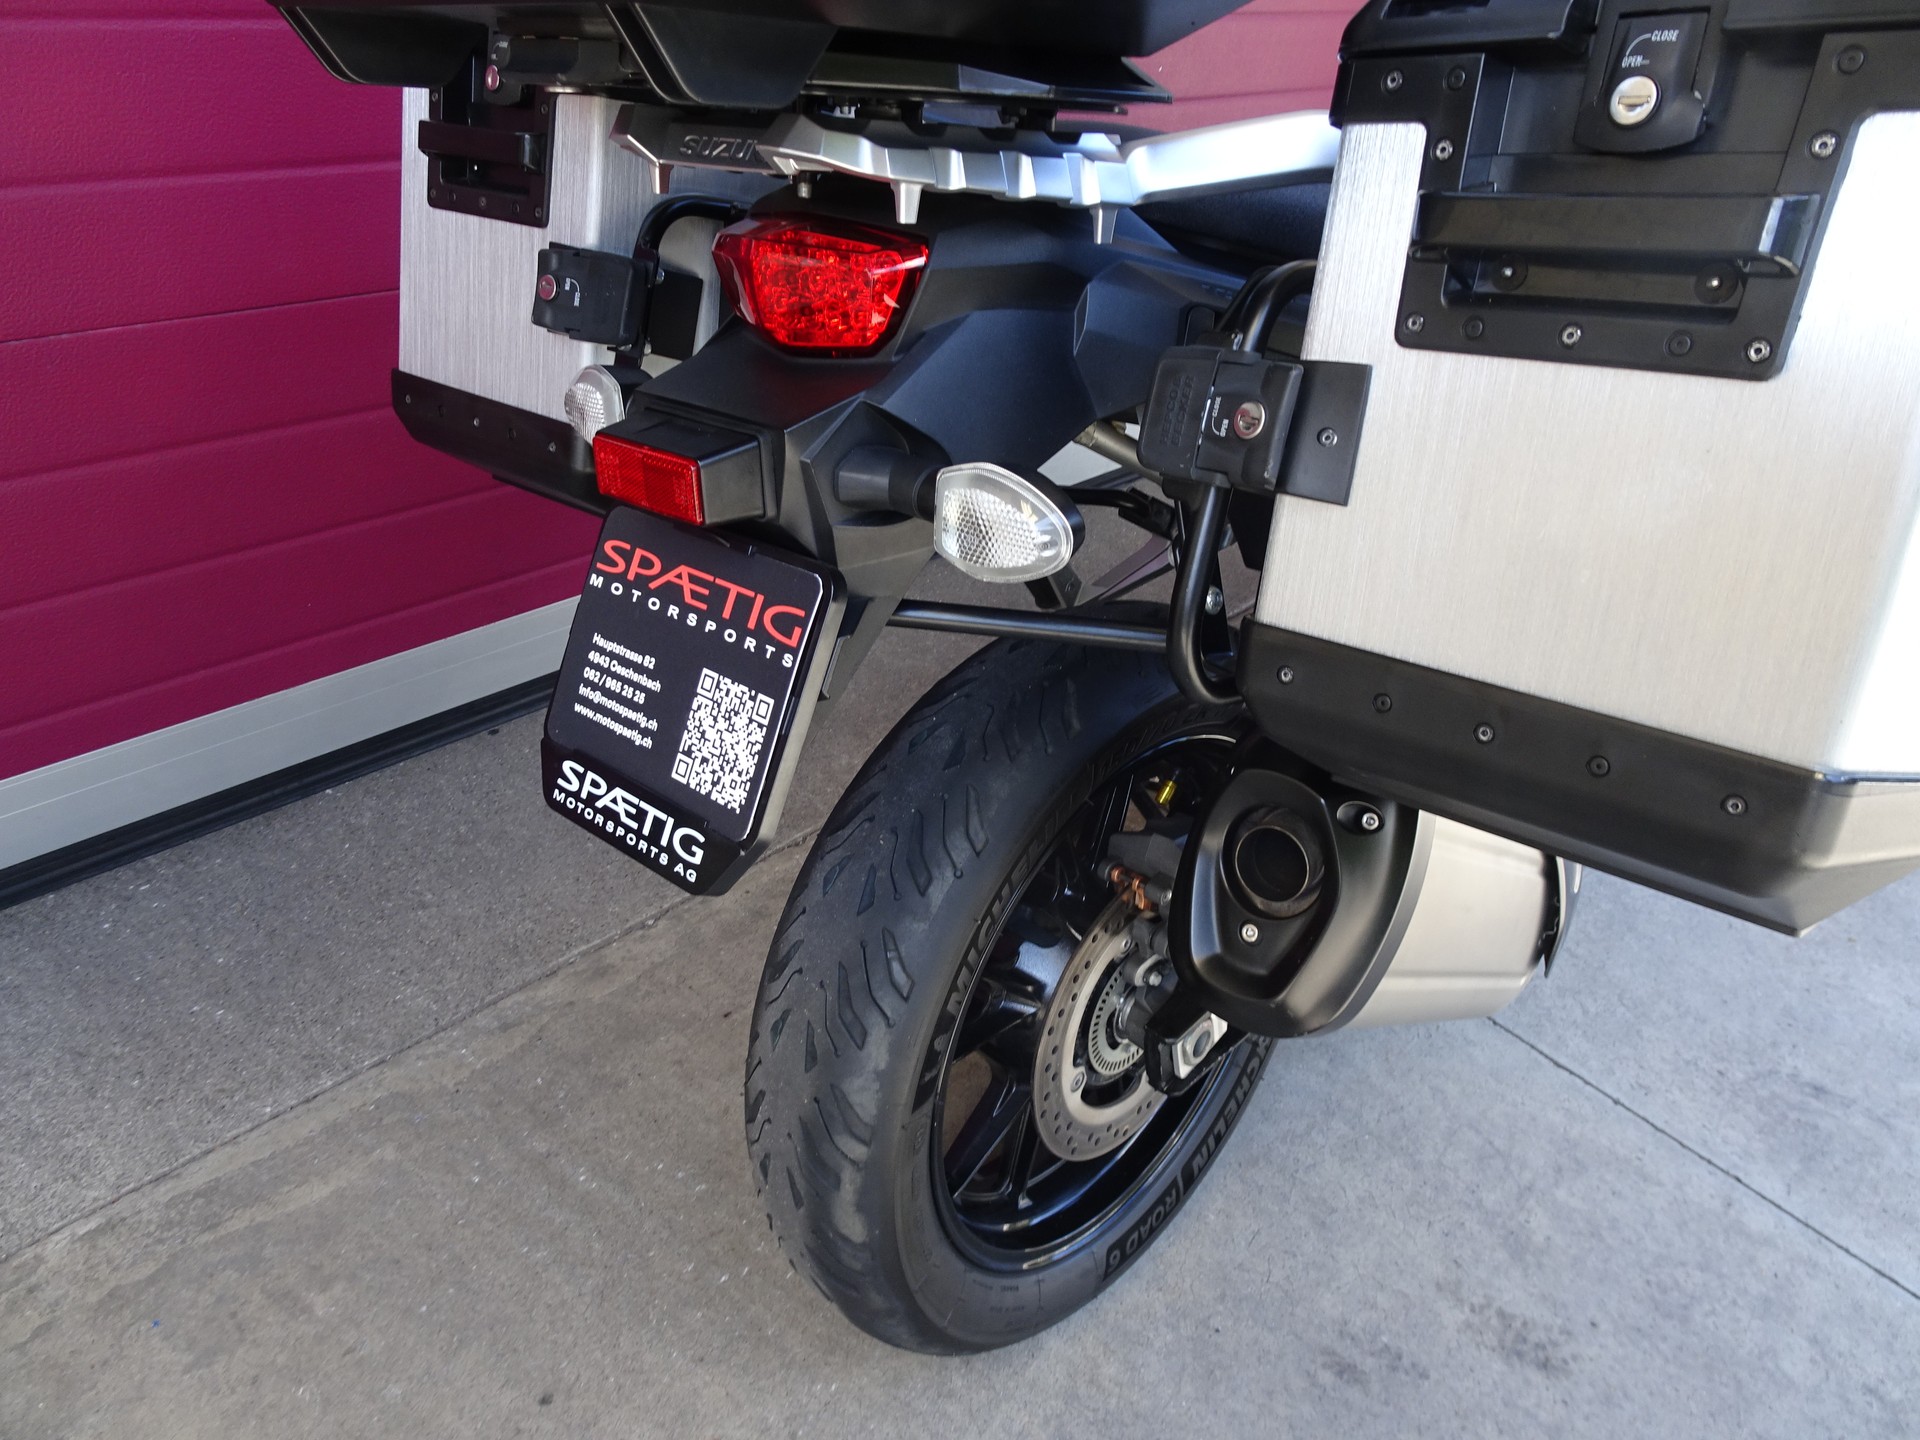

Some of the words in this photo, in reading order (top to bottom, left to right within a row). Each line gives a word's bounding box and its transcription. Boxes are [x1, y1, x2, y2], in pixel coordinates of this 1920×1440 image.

[1651, 29, 1679, 42] CLOSE
[1621, 55, 1643, 68] OPEN
[596, 539, 806, 648] SPÆTIG
[589, 573, 794, 668] MOTORSPORTS
[588, 650, 610, 668] 4943
[610, 660, 661, 693] Oeschenbach
[592, 632, 643, 664] Hauptstrasse
[643, 655, 656, 669] 82
[583, 667, 600, 683] 062
[605, 677, 622, 693] 965
[621, 685, 634, 699] 25
[633, 689, 646, 704] 25
[574, 702, 653, 749] www.motospaetig.ch
[557, 760, 706, 865] SPÆTIG
[553, 788, 669, 865] MOTORSPORTS
[673, 863, 698, 883] AG
[1125, 1184, 1178, 1251] ROAD
[1108, 1251, 1121, 1266] 6
